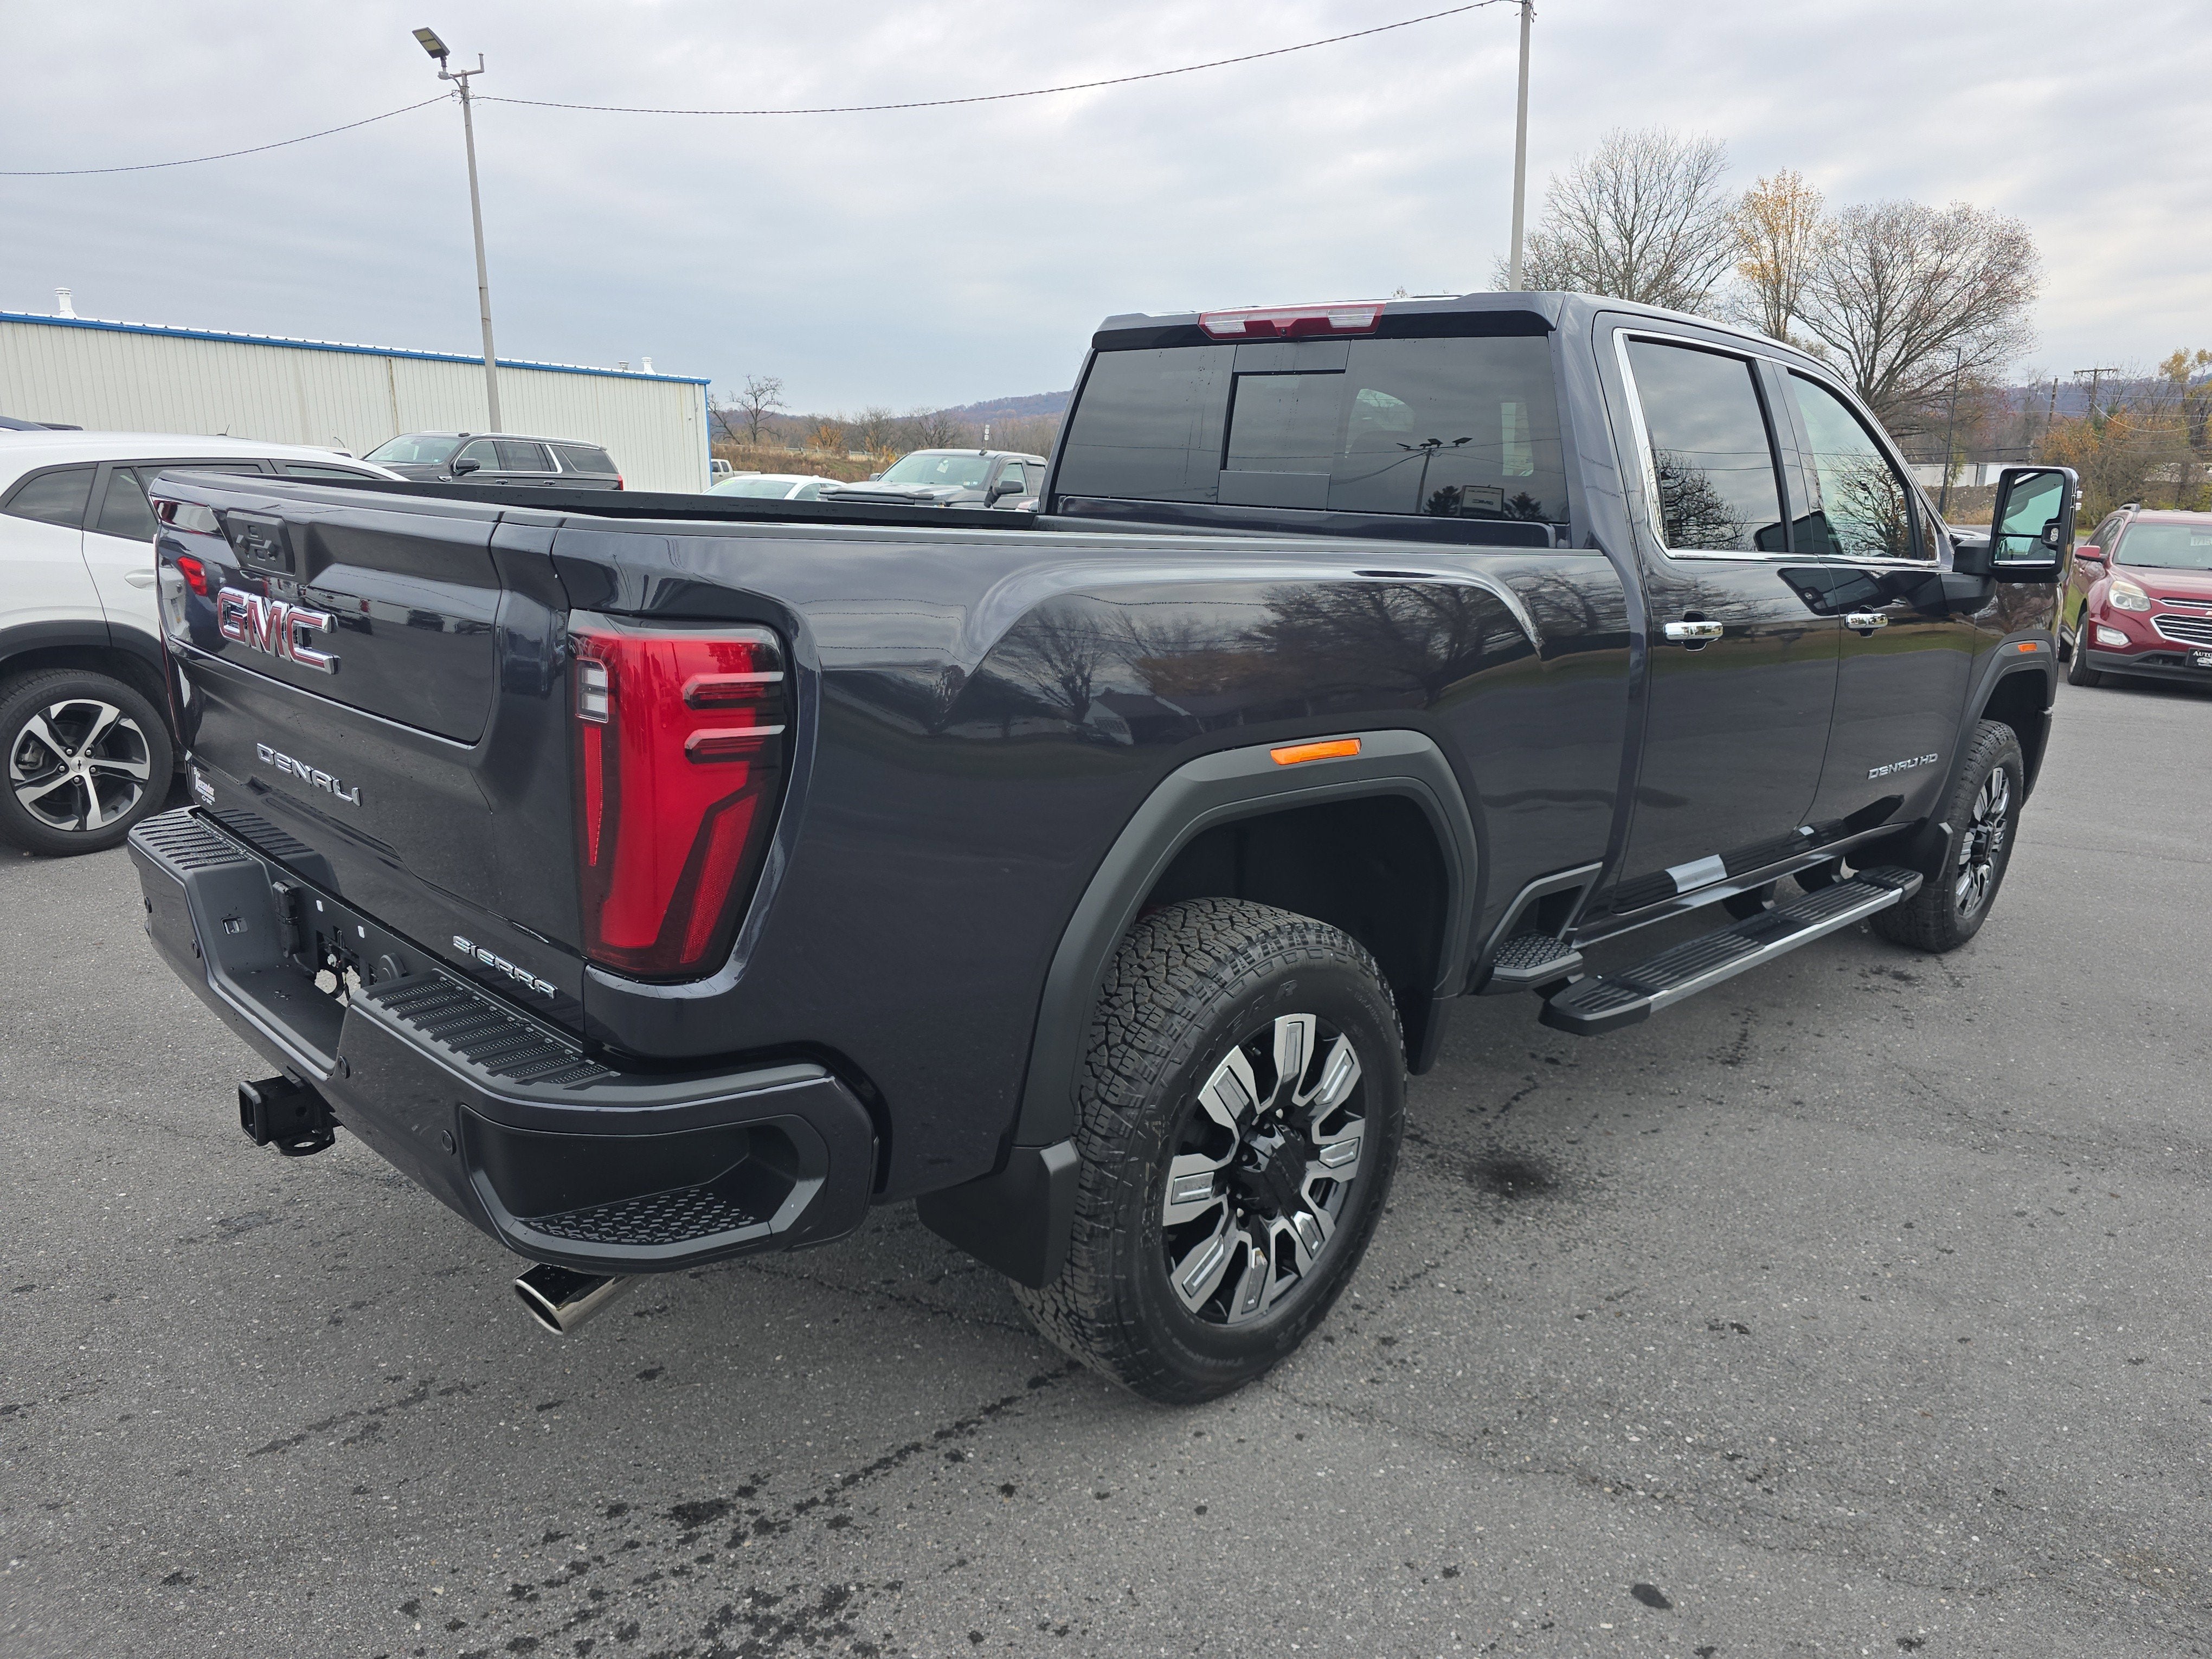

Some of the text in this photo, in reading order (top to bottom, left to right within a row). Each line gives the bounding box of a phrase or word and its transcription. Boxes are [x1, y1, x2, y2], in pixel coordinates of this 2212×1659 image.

[217, 587, 340, 674] GMC
[256, 743, 362, 807] DENALI
[1867, 753, 1938, 780] DENALI HD
[453, 935, 558, 999] SIERRA
